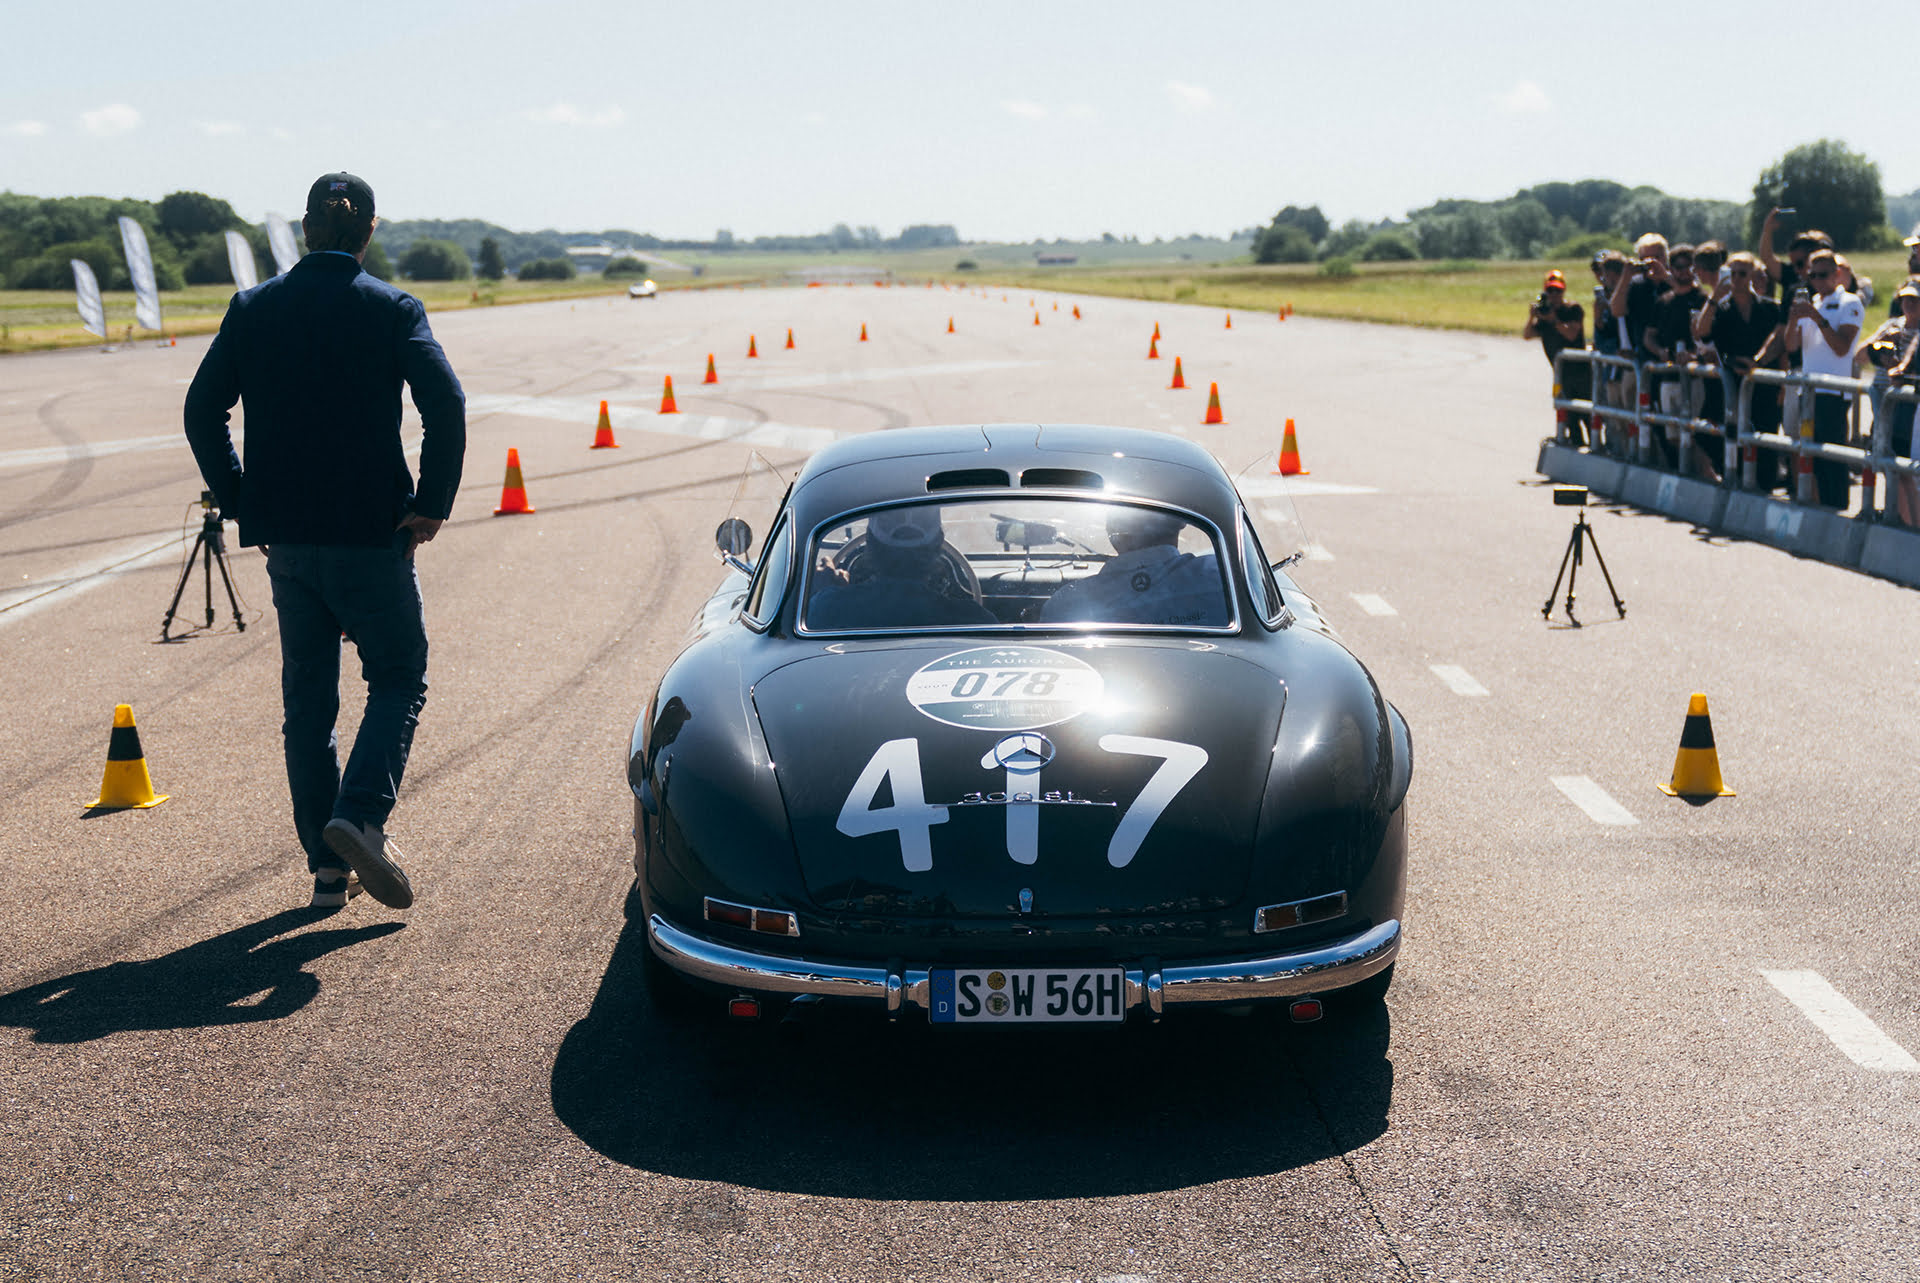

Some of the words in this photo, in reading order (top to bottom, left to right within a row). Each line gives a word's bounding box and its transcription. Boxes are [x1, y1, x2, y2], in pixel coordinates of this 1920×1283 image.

[947, 658, 982, 666] THE
[951, 671, 1060, 698] 078
[836, 732, 1209, 871] 417
[938, 1001, 948, 1013] D
[958, 974, 982, 1017] S
[1012, 974, 1035, 1017] W
[1046, 974, 1120, 1016] 56H
